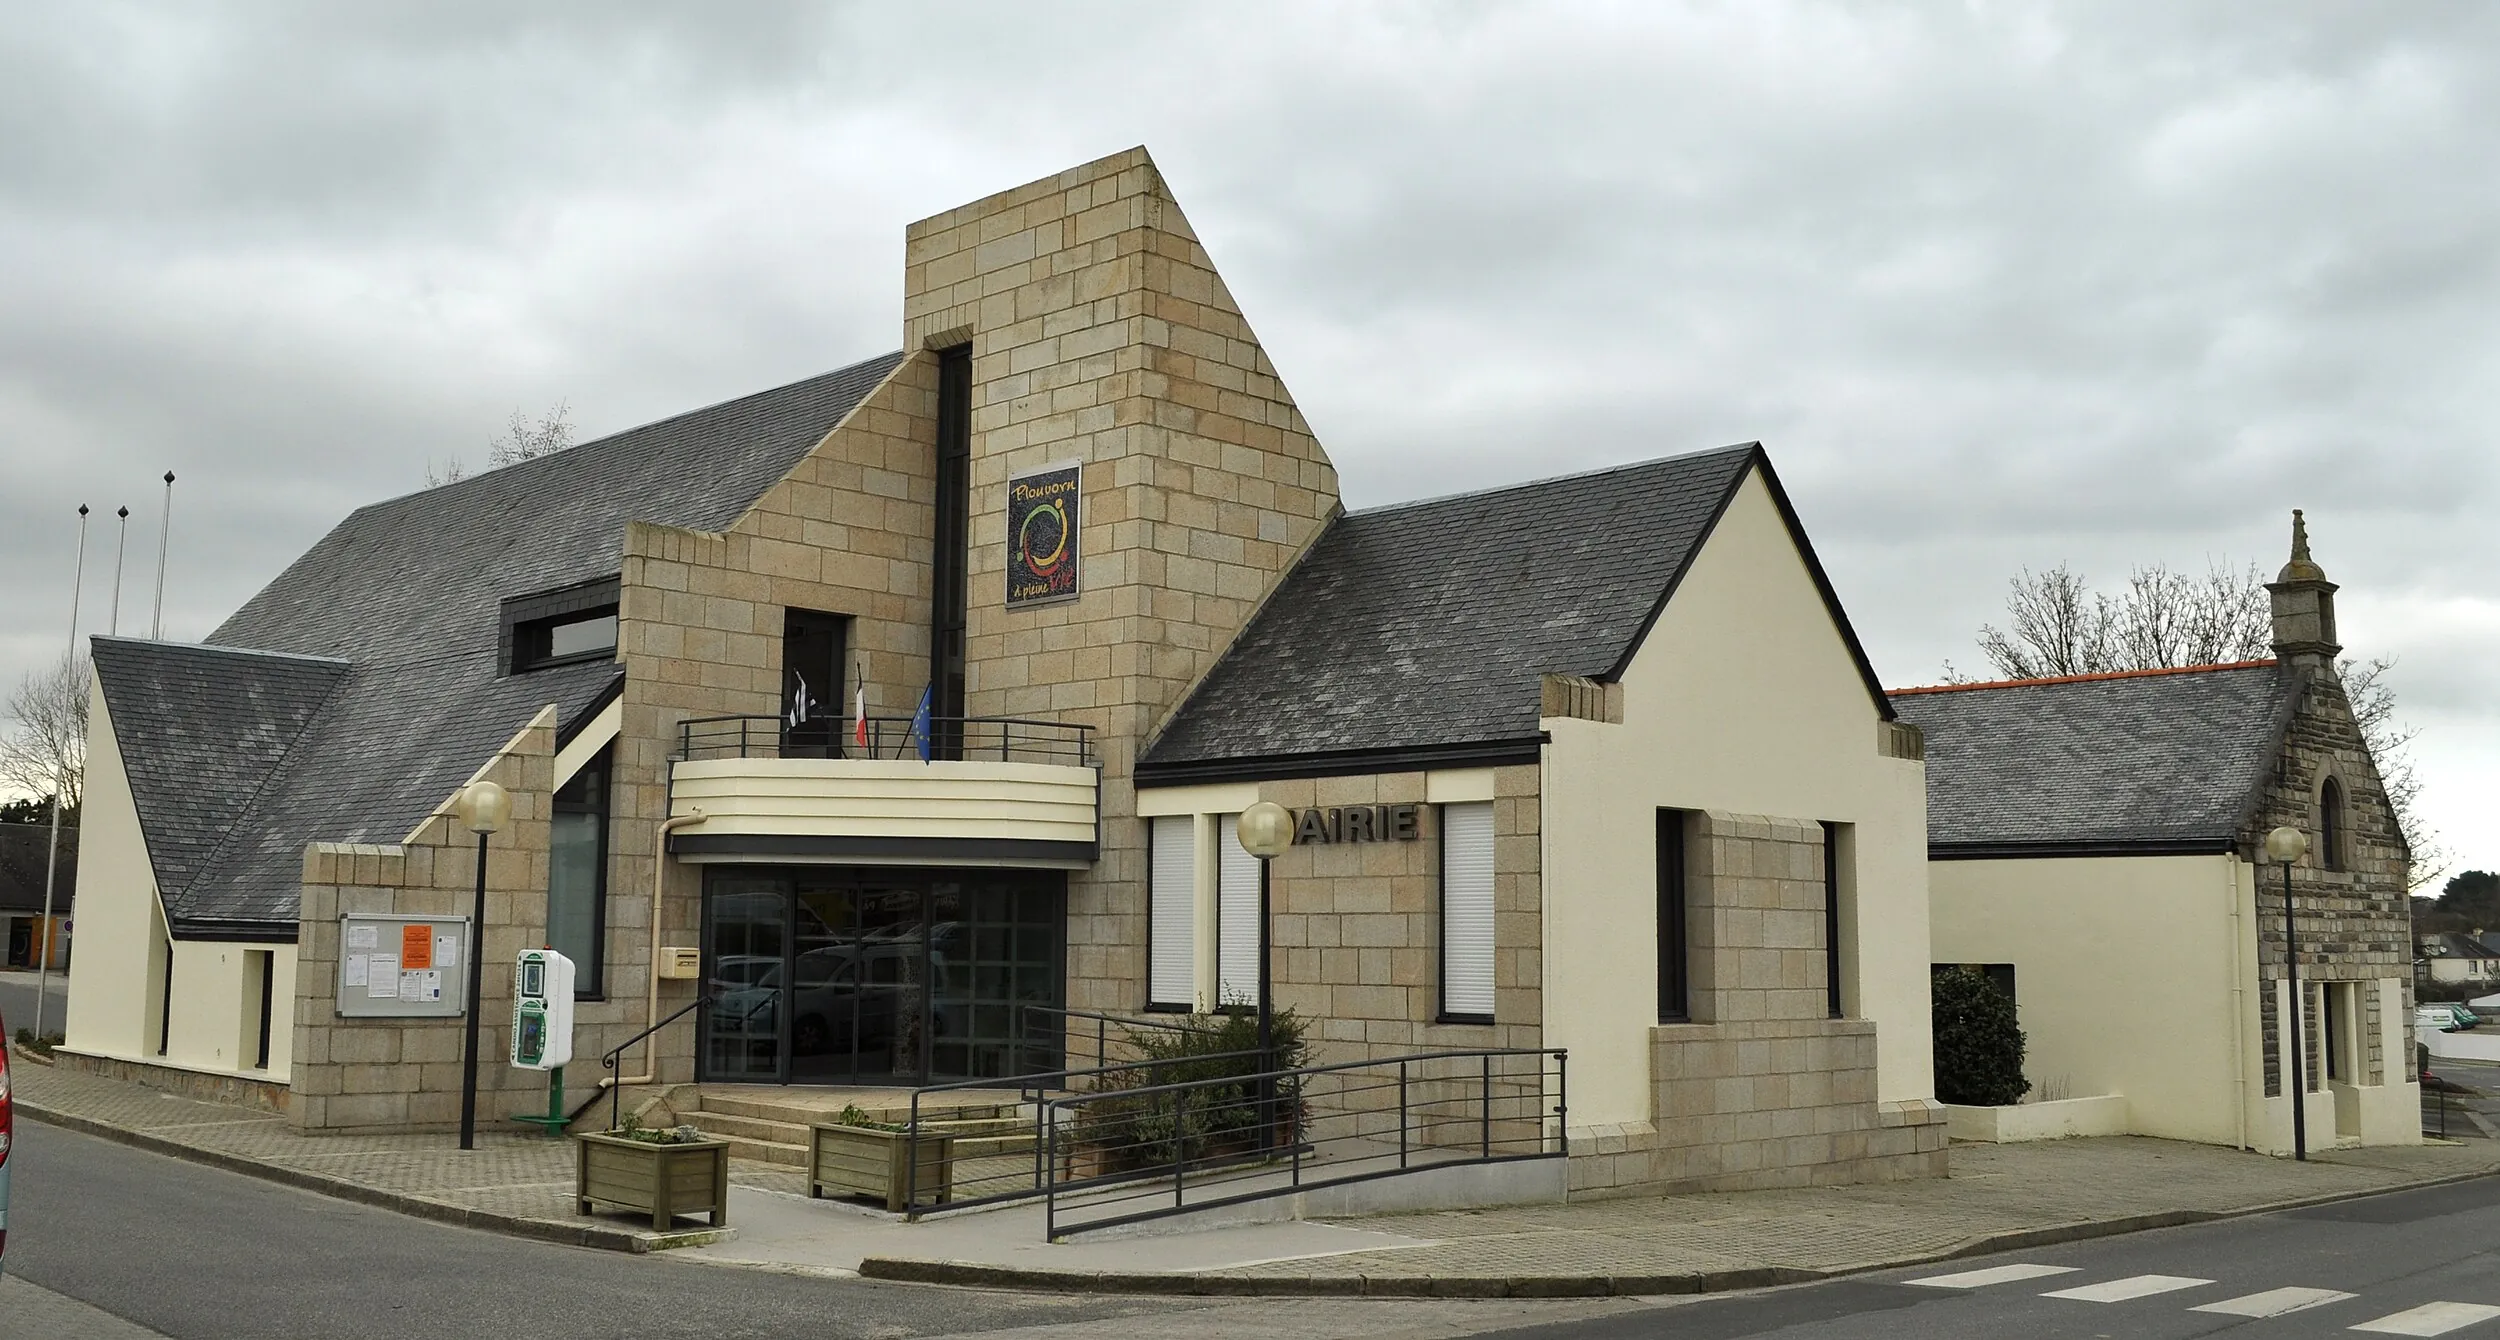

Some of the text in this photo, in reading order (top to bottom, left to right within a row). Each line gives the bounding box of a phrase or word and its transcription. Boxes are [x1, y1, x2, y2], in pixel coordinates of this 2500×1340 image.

[1011, 481, 1076, 501] Plouvorn
[1023, 582, 1049, 601] pleine
[1288, 804, 1416, 845] AIRIE
[513, 988, 521, 1027] ASSISTANCE
